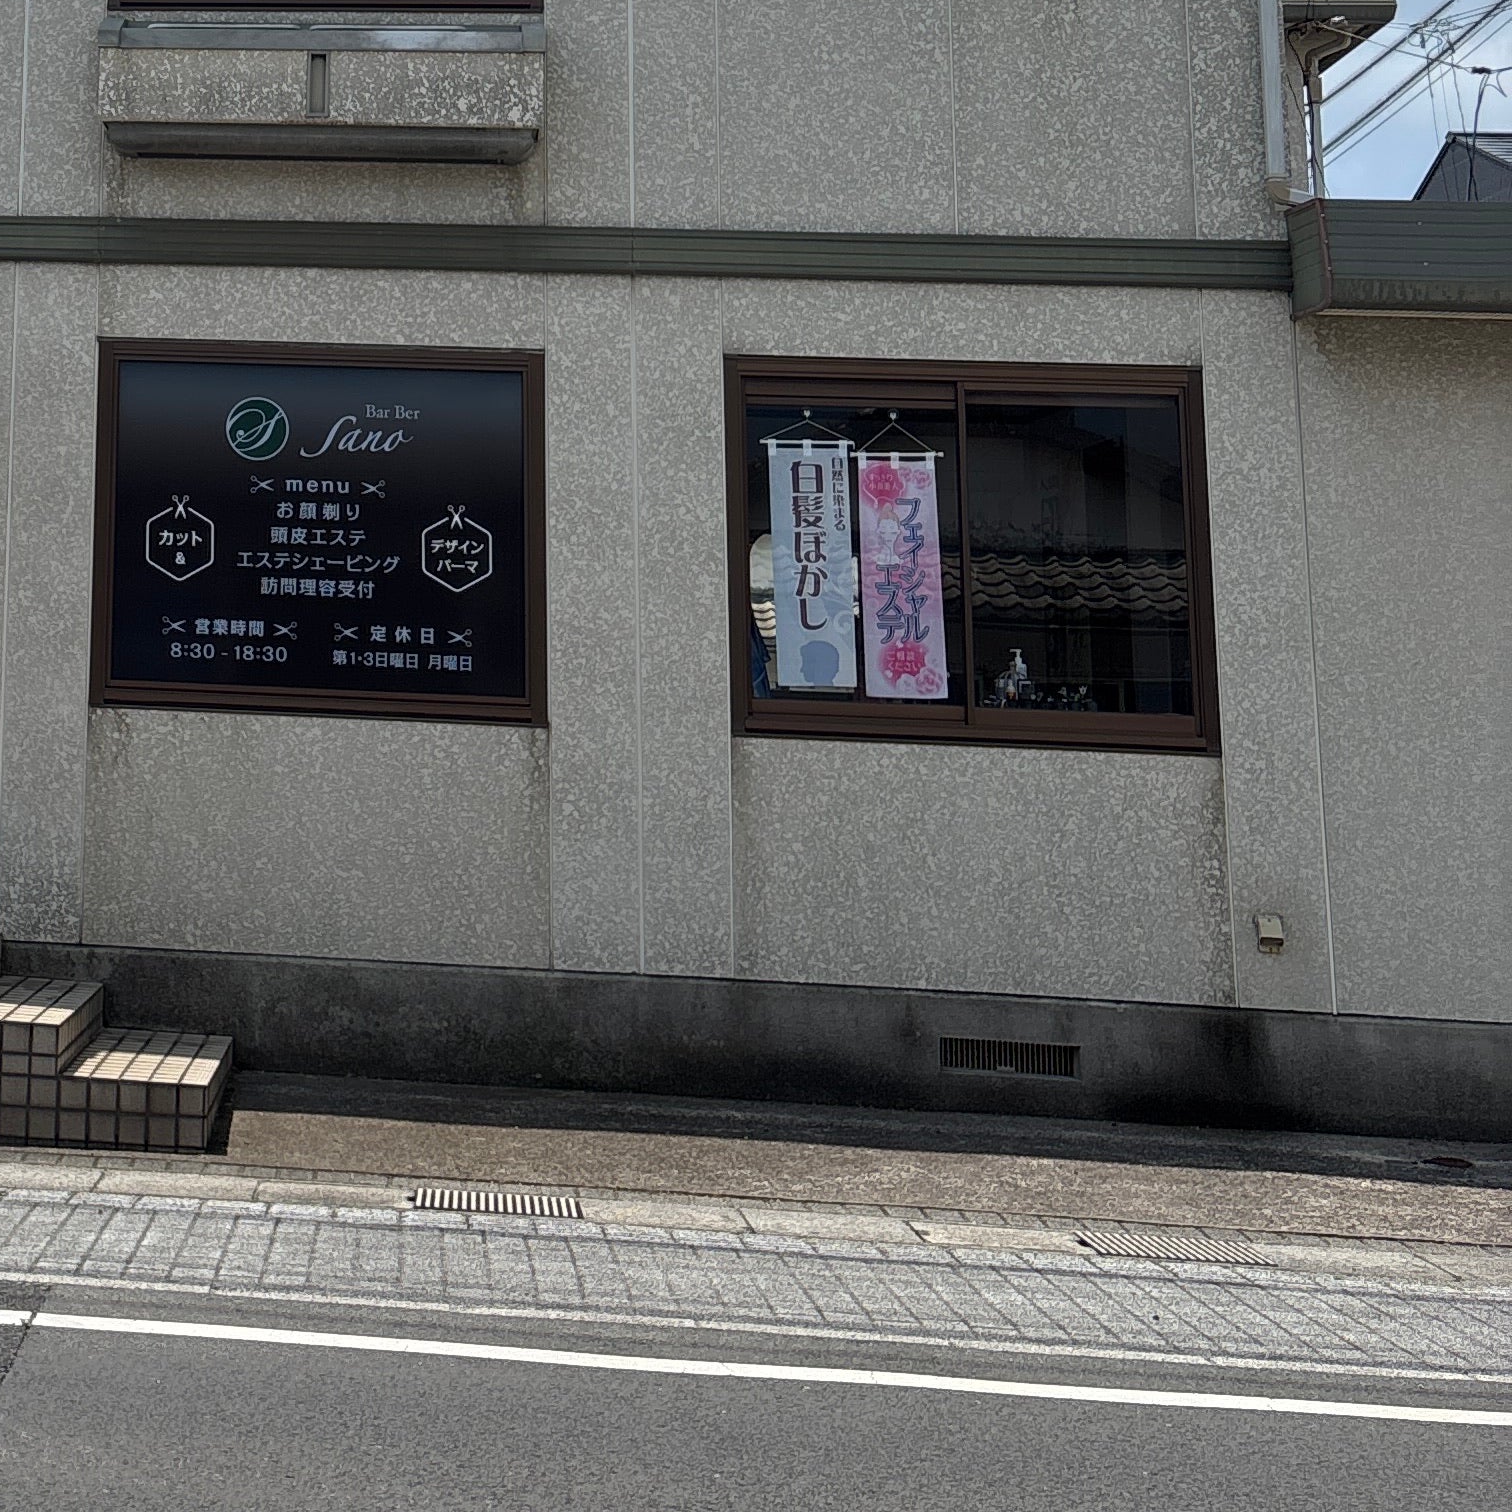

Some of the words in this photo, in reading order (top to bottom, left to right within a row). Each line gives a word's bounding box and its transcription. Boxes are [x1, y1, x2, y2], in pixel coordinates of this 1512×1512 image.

[364, 404, 390, 419] Bar
[394, 404, 421, 420] Ber
[299, 415, 414, 458] Sano
[285, 479, 350, 494] menu
[276, 501, 360, 521] お顔剃り
[158, 529, 203, 547] カット
[270, 526, 366, 547] 頭皮エステ
[790, 460, 828, 631] 白髪ぼかし
[430, 539, 485, 555] デザイン
[175, 551, 186, 565] &
[236, 551, 401, 574] エステシェービング
[436, 558, 479, 574] パーマ
[895, 497, 930, 644] フェイシャル
[260, 576, 376, 599] 訪問理容受付
[875, 563, 905, 644] エステ
[194, 618, 265, 637] 営業時間
[370, 624, 435, 645] 定休日
[170, 642, 215, 659] 8:30
[233, 645, 288, 662] 18:30
[427, 654, 472, 671] 月曜日
